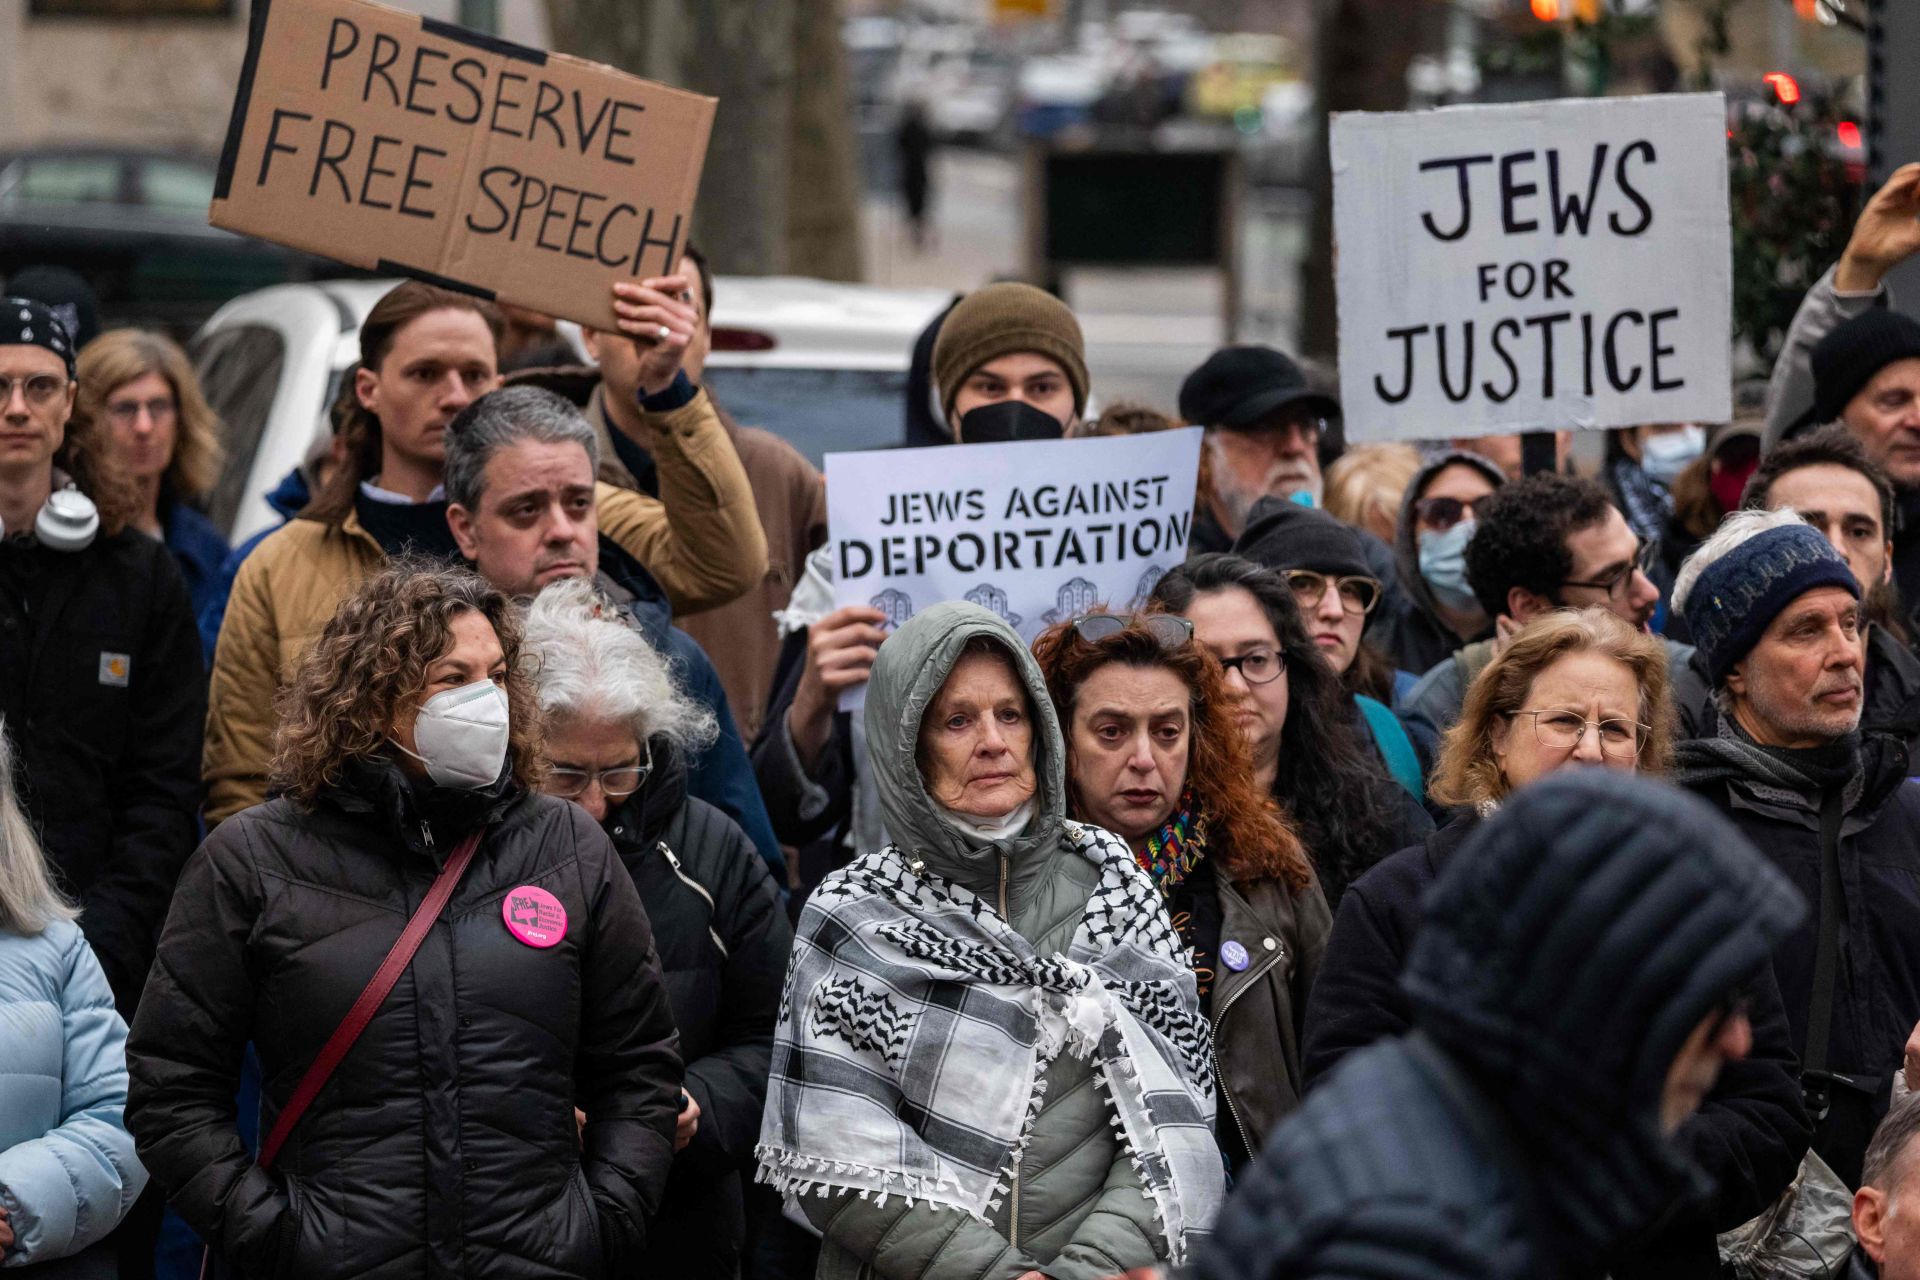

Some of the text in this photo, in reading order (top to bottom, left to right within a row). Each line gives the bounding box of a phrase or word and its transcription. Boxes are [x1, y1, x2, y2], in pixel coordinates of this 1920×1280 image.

[320, 17, 645, 165] PRESERVE
[257, 108, 682, 277] FREE SPEECH
[1419, 139, 1657, 242] JEWS
[1477, 258, 1574, 302] FOR
[1374, 308, 1685, 405] JUSTICE
[840, 511, 1190, 579] DEPORTATION
[880, 475, 1169, 525] JEWS AGAINST
